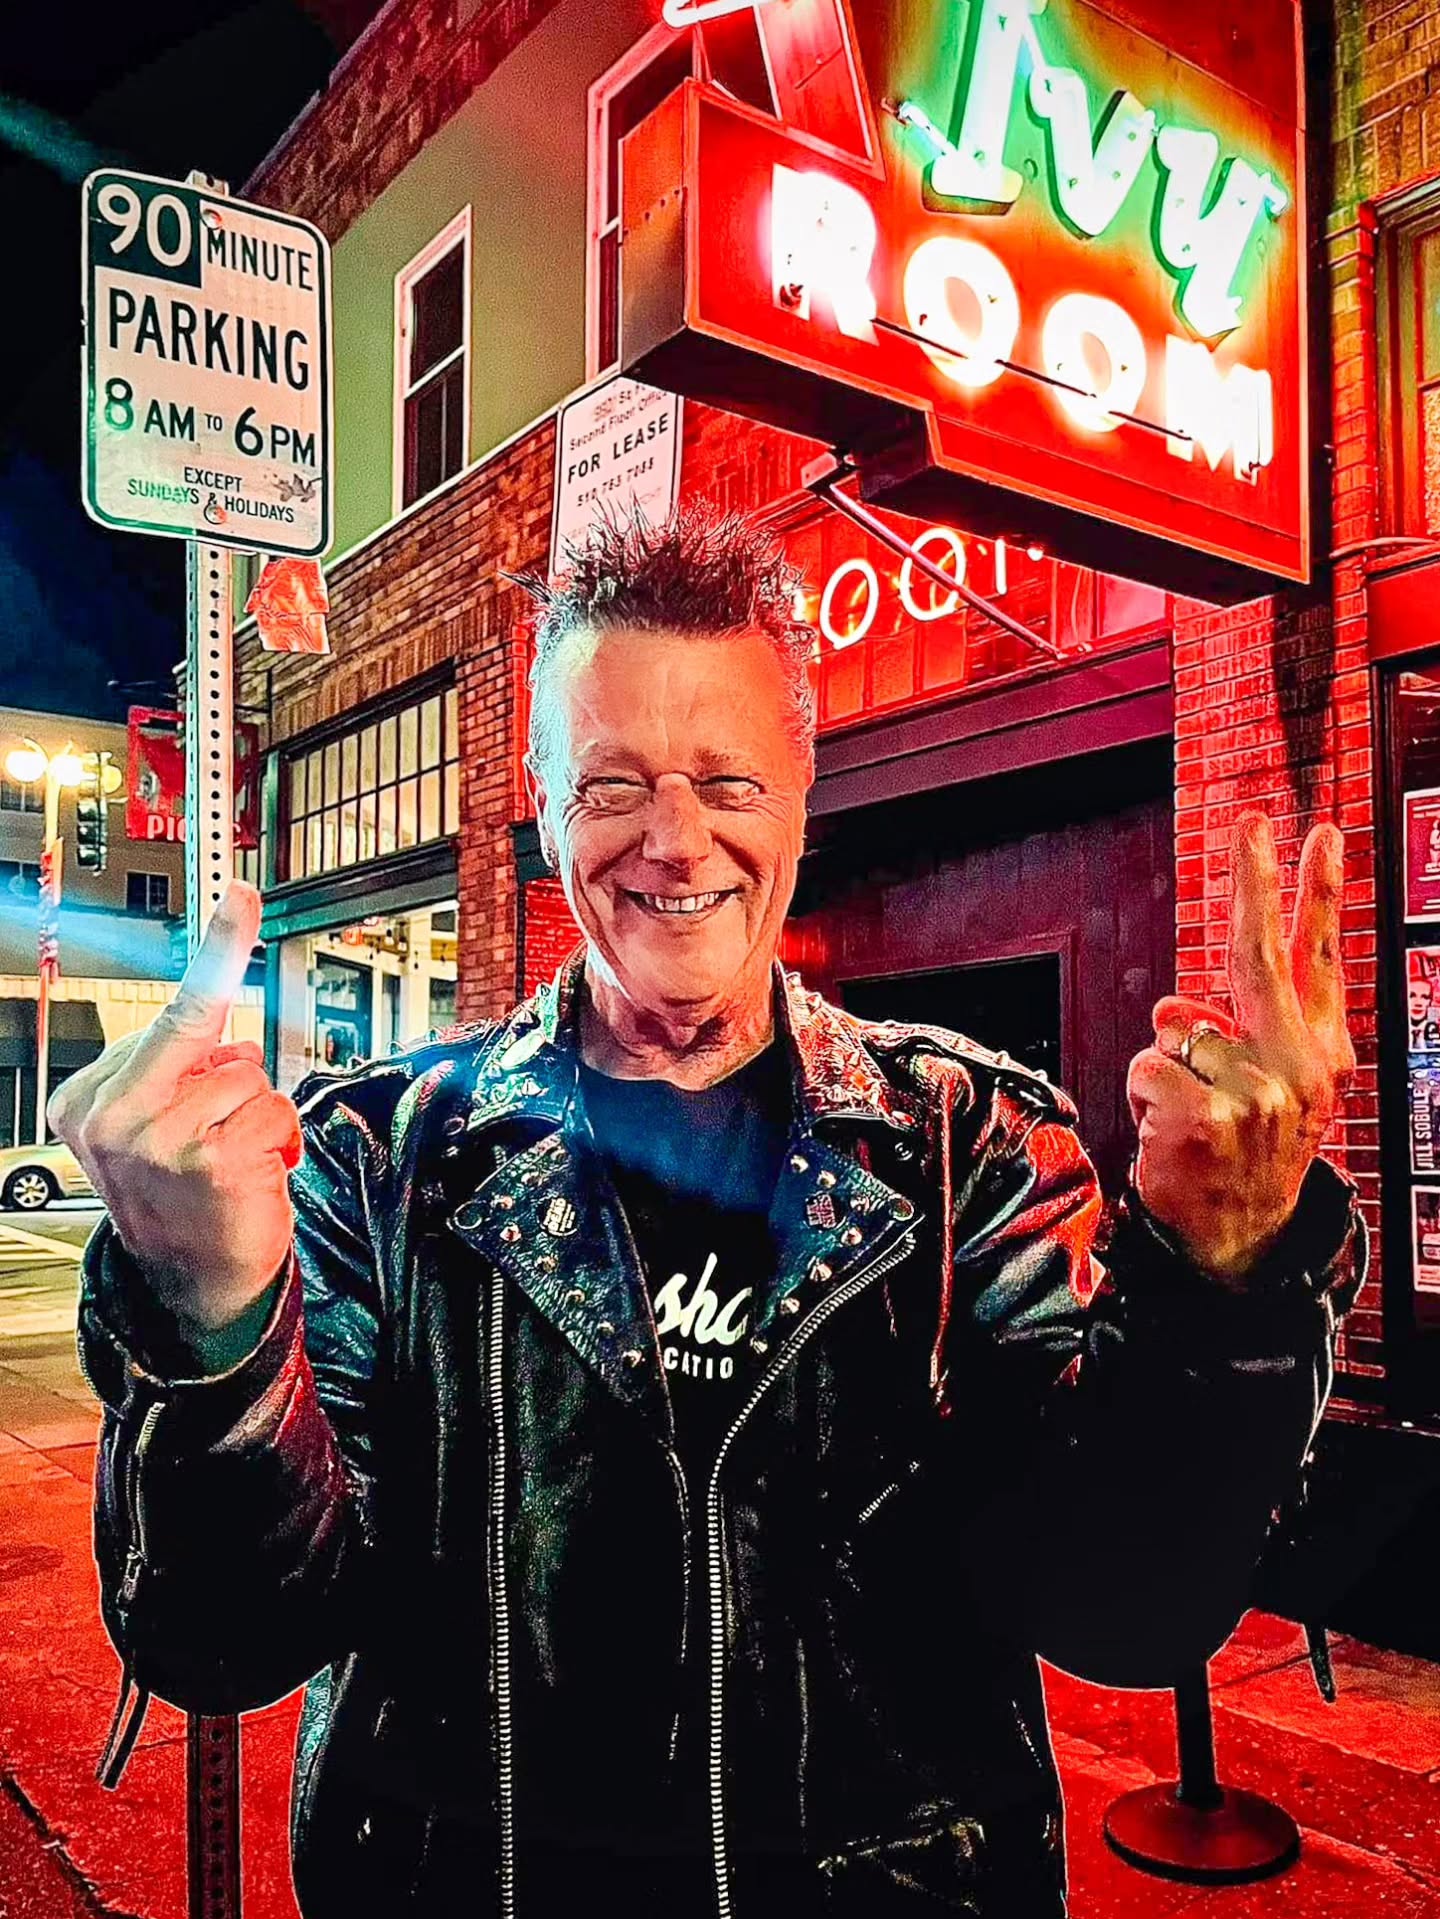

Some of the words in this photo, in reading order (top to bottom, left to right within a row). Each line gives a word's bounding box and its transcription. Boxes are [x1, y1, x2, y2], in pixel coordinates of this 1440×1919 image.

[97, 183, 192, 268] 90
[207, 229, 313, 291] MINUTE
[108, 286, 310, 391] PARKING
[772, 163, 1272, 484] ROOM
[104, 377, 134, 431] 8
[144, 399, 195, 442] AM
[204, 413, 223, 432] TO
[184, 466, 243, 493] EXCEPT
[568, 452, 601, 484] FOR
[613, 412, 669, 460] LEASE
[127, 478, 199, 504] SUNDAYS
[224, 497, 295, 523] HOLIDAYS
[1415, 1142, 1434, 1169] JILL
